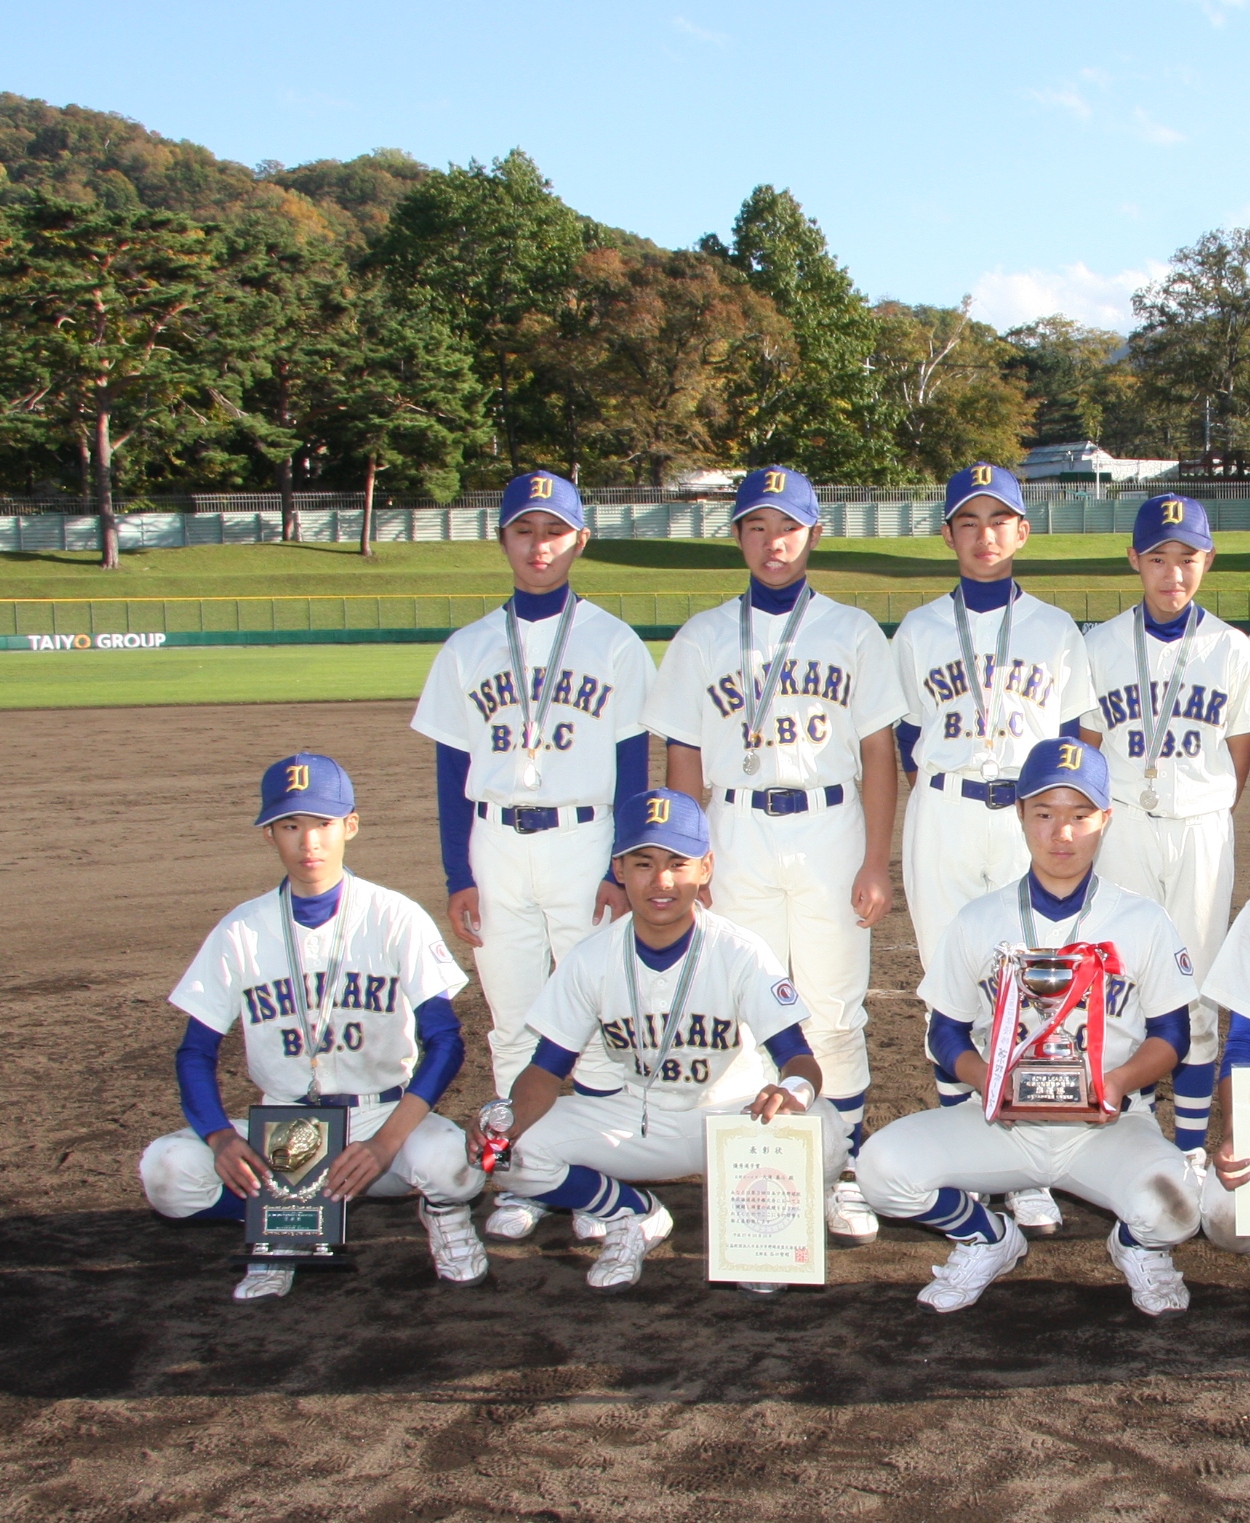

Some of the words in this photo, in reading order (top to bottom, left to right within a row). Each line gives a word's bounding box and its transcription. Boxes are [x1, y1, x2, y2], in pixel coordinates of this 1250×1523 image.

[28, 634, 92, 650] TAIYO
[97, 632, 166, 649] GROUP
[468, 666, 615, 724] ISHKARI
[706, 658, 852, 709] ISKARI
